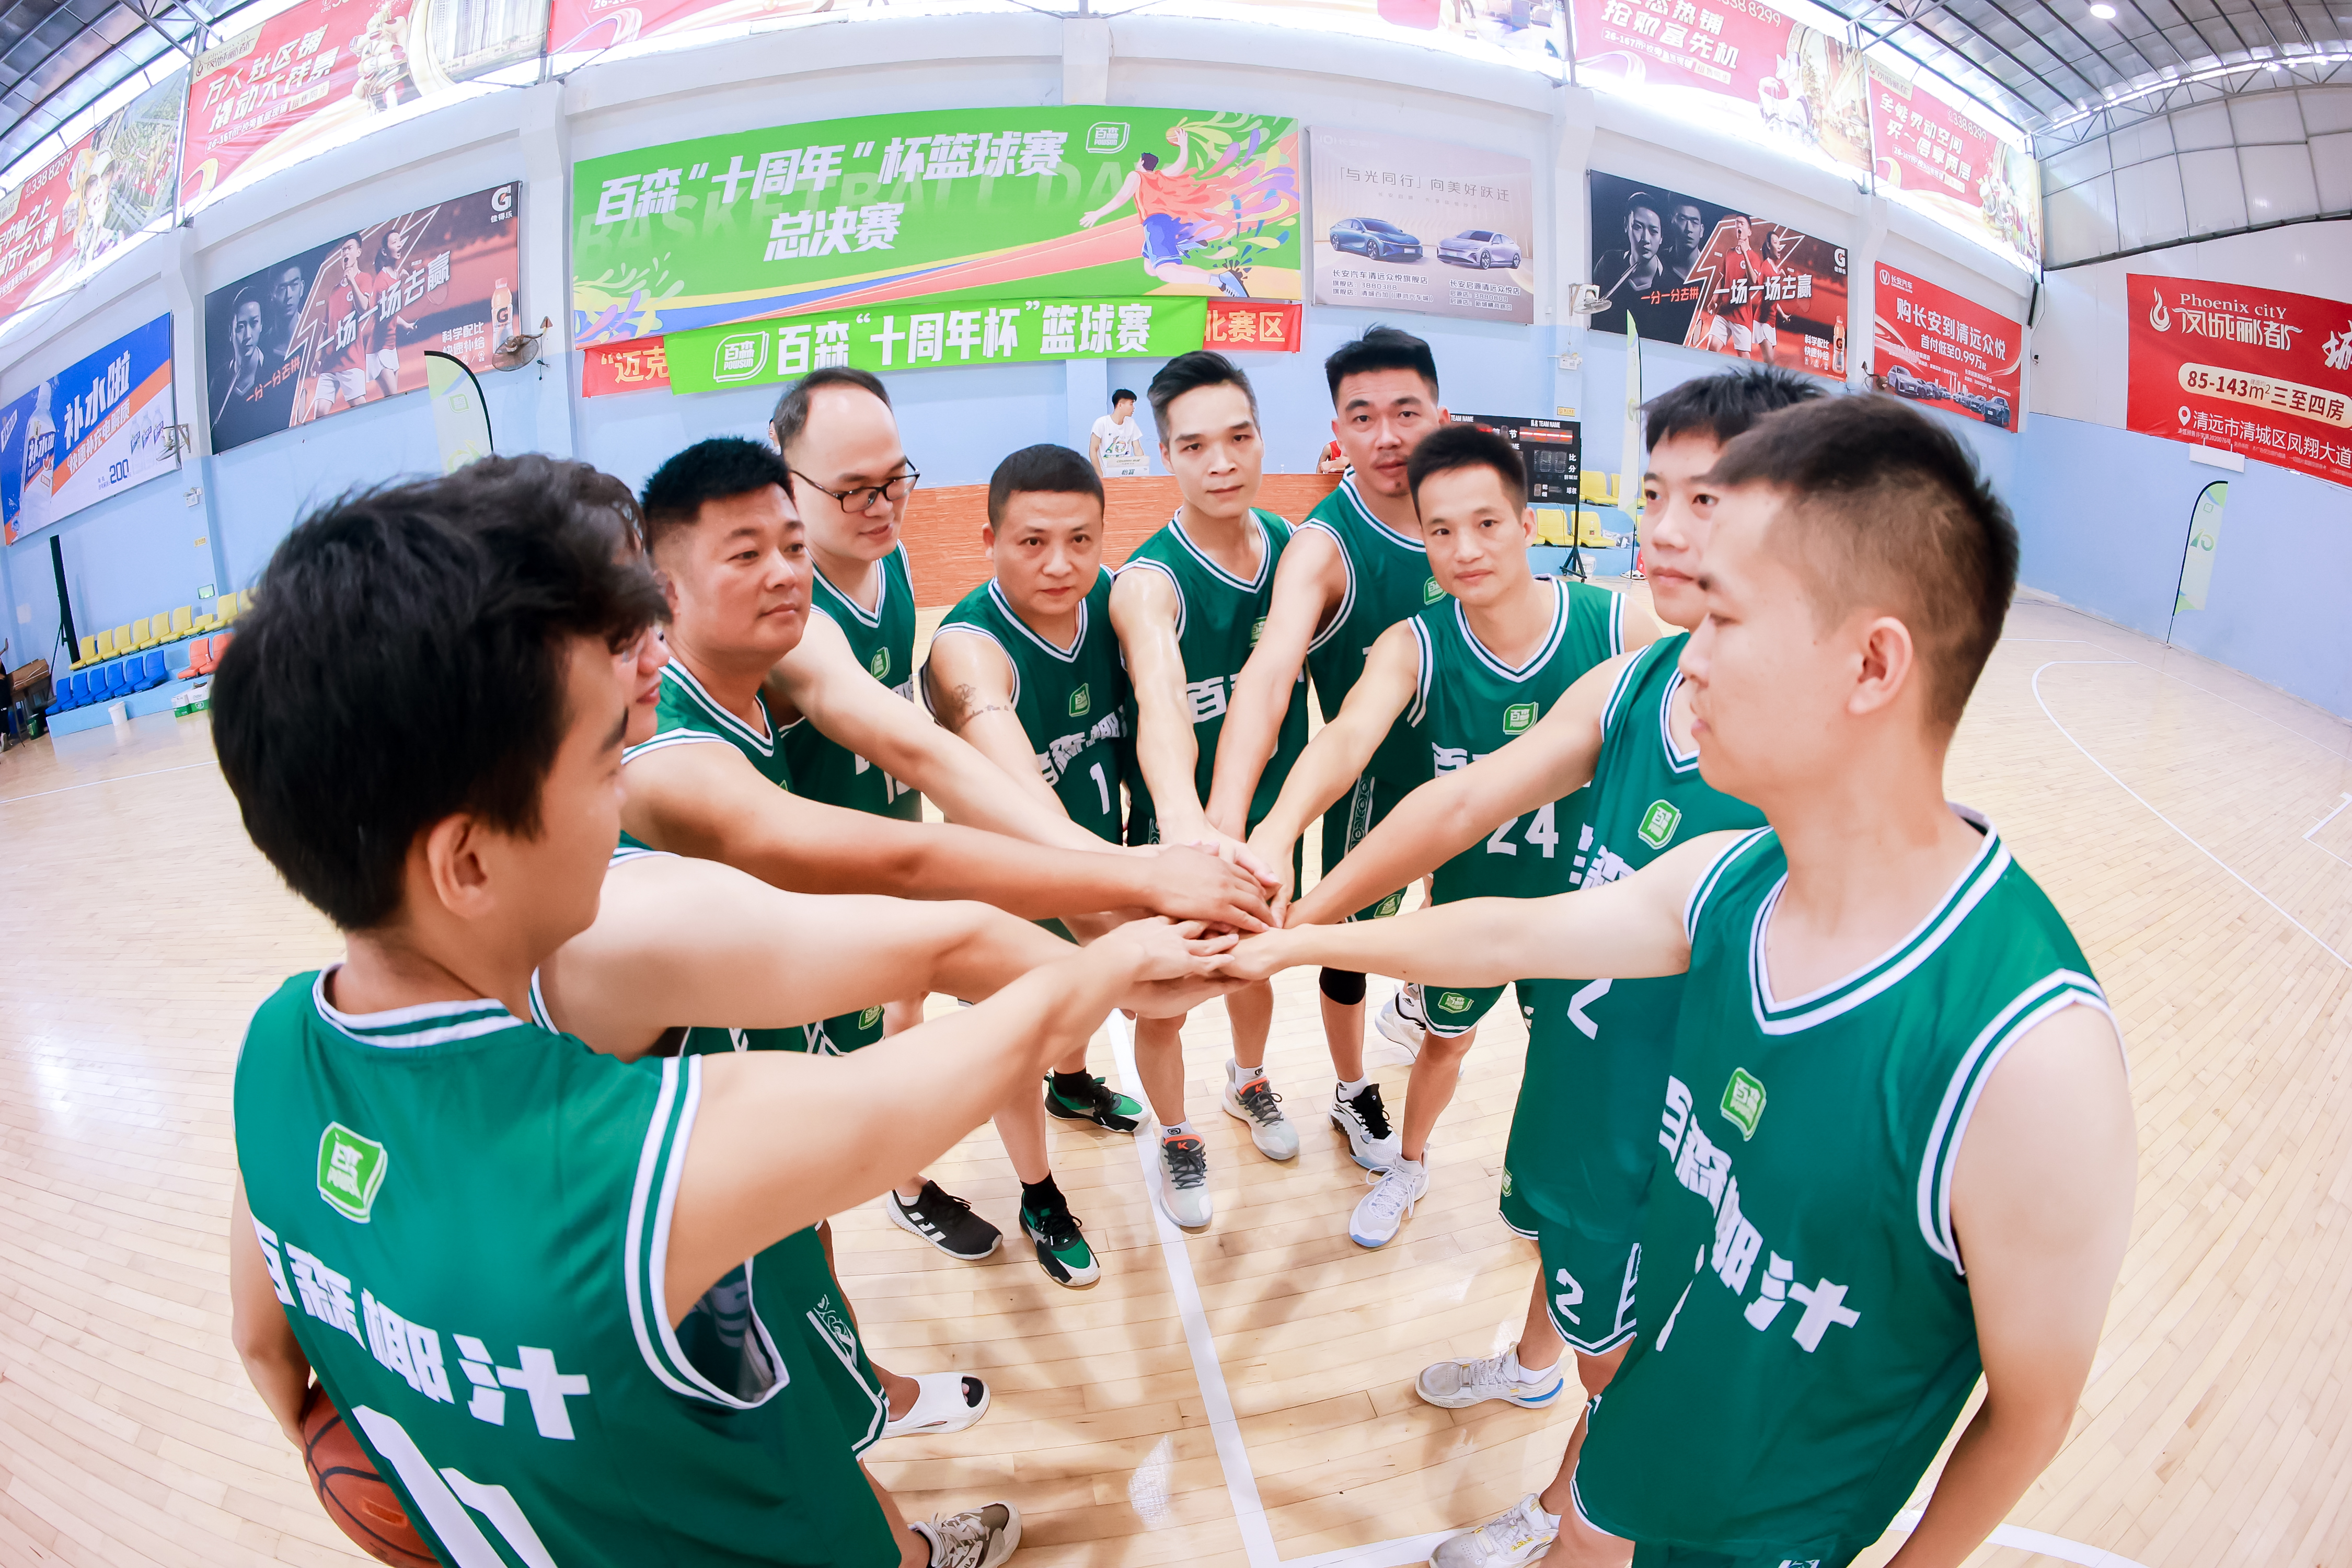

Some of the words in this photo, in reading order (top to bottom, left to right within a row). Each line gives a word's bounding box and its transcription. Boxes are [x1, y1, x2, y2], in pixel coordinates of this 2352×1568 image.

[1601, 1, 1739, 70] 抢财富先机
[1431, 178, 1509, 202] 向美好跃迁
[491, 210, 513, 224] 佳得乐
[763, 202, 905, 262] 总决赛
[1333, 269, 1428, 284] 长安汽车清远众悦旗舰店
[1713, 273, 1812, 305] 一场一场去赢
[1892, 275, 1912, 290] 长安汽车
[316, 250, 451, 352] 一场一场去赢
[1641, 286, 1699, 305] 一分一分去拼
[2180, 293, 2249, 314] Phoenix
[442, 321, 485, 343] 科学配比
[1805, 334, 1829, 350] 科学配比
[1897, 297, 2005, 361] 购长安到清远众悦
[442, 336, 485, 356] 快速补给
[1804, 346, 1829, 361] 快速补给
[1921, 334, 1987, 371] 首付低至0.99万起
[246, 355, 300, 402] 一分一分去拼
[64, 350, 131, 451] 补水啦
[67, 398, 130, 475] 快速补充电解质
[1509, 429, 1517, 439] 节
[2193, 410, 2352, 468] 清远市清城区凤翔大道
[109, 458, 129, 484] 200
[1089, 762, 1110, 815] 1
